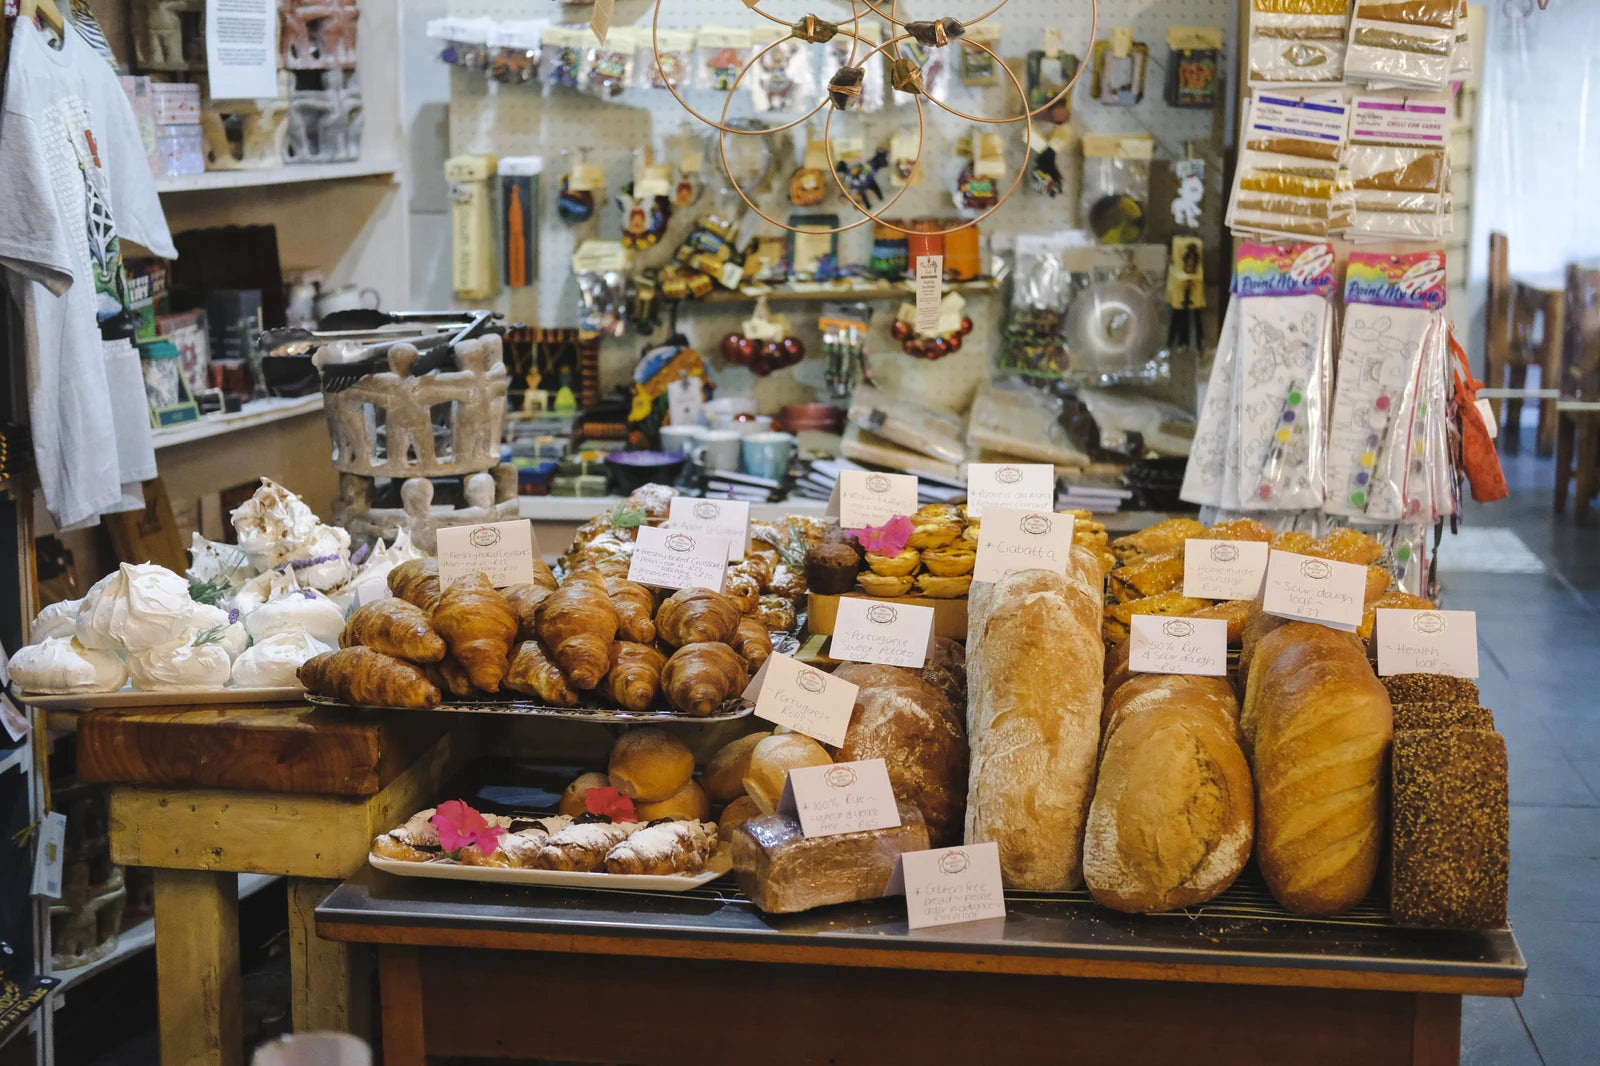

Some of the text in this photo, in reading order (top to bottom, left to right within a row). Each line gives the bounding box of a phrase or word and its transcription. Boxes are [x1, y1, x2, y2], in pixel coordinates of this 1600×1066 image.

[1242, 274, 1274, 291] Paint
[1277, 273, 1299, 291] My
[1348, 280, 1381, 297] Paint
[1384, 283, 1407, 301] My
[997, 541, 1057, 562] Ciabatta
[1289, 593, 1314, 606] loaf
[1181, 641, 1202, 655] Rye
[1396, 642, 1440, 657] Health
[1415, 657, 1438, 668] loaf
[773, 689, 832, 721] Portuguese
